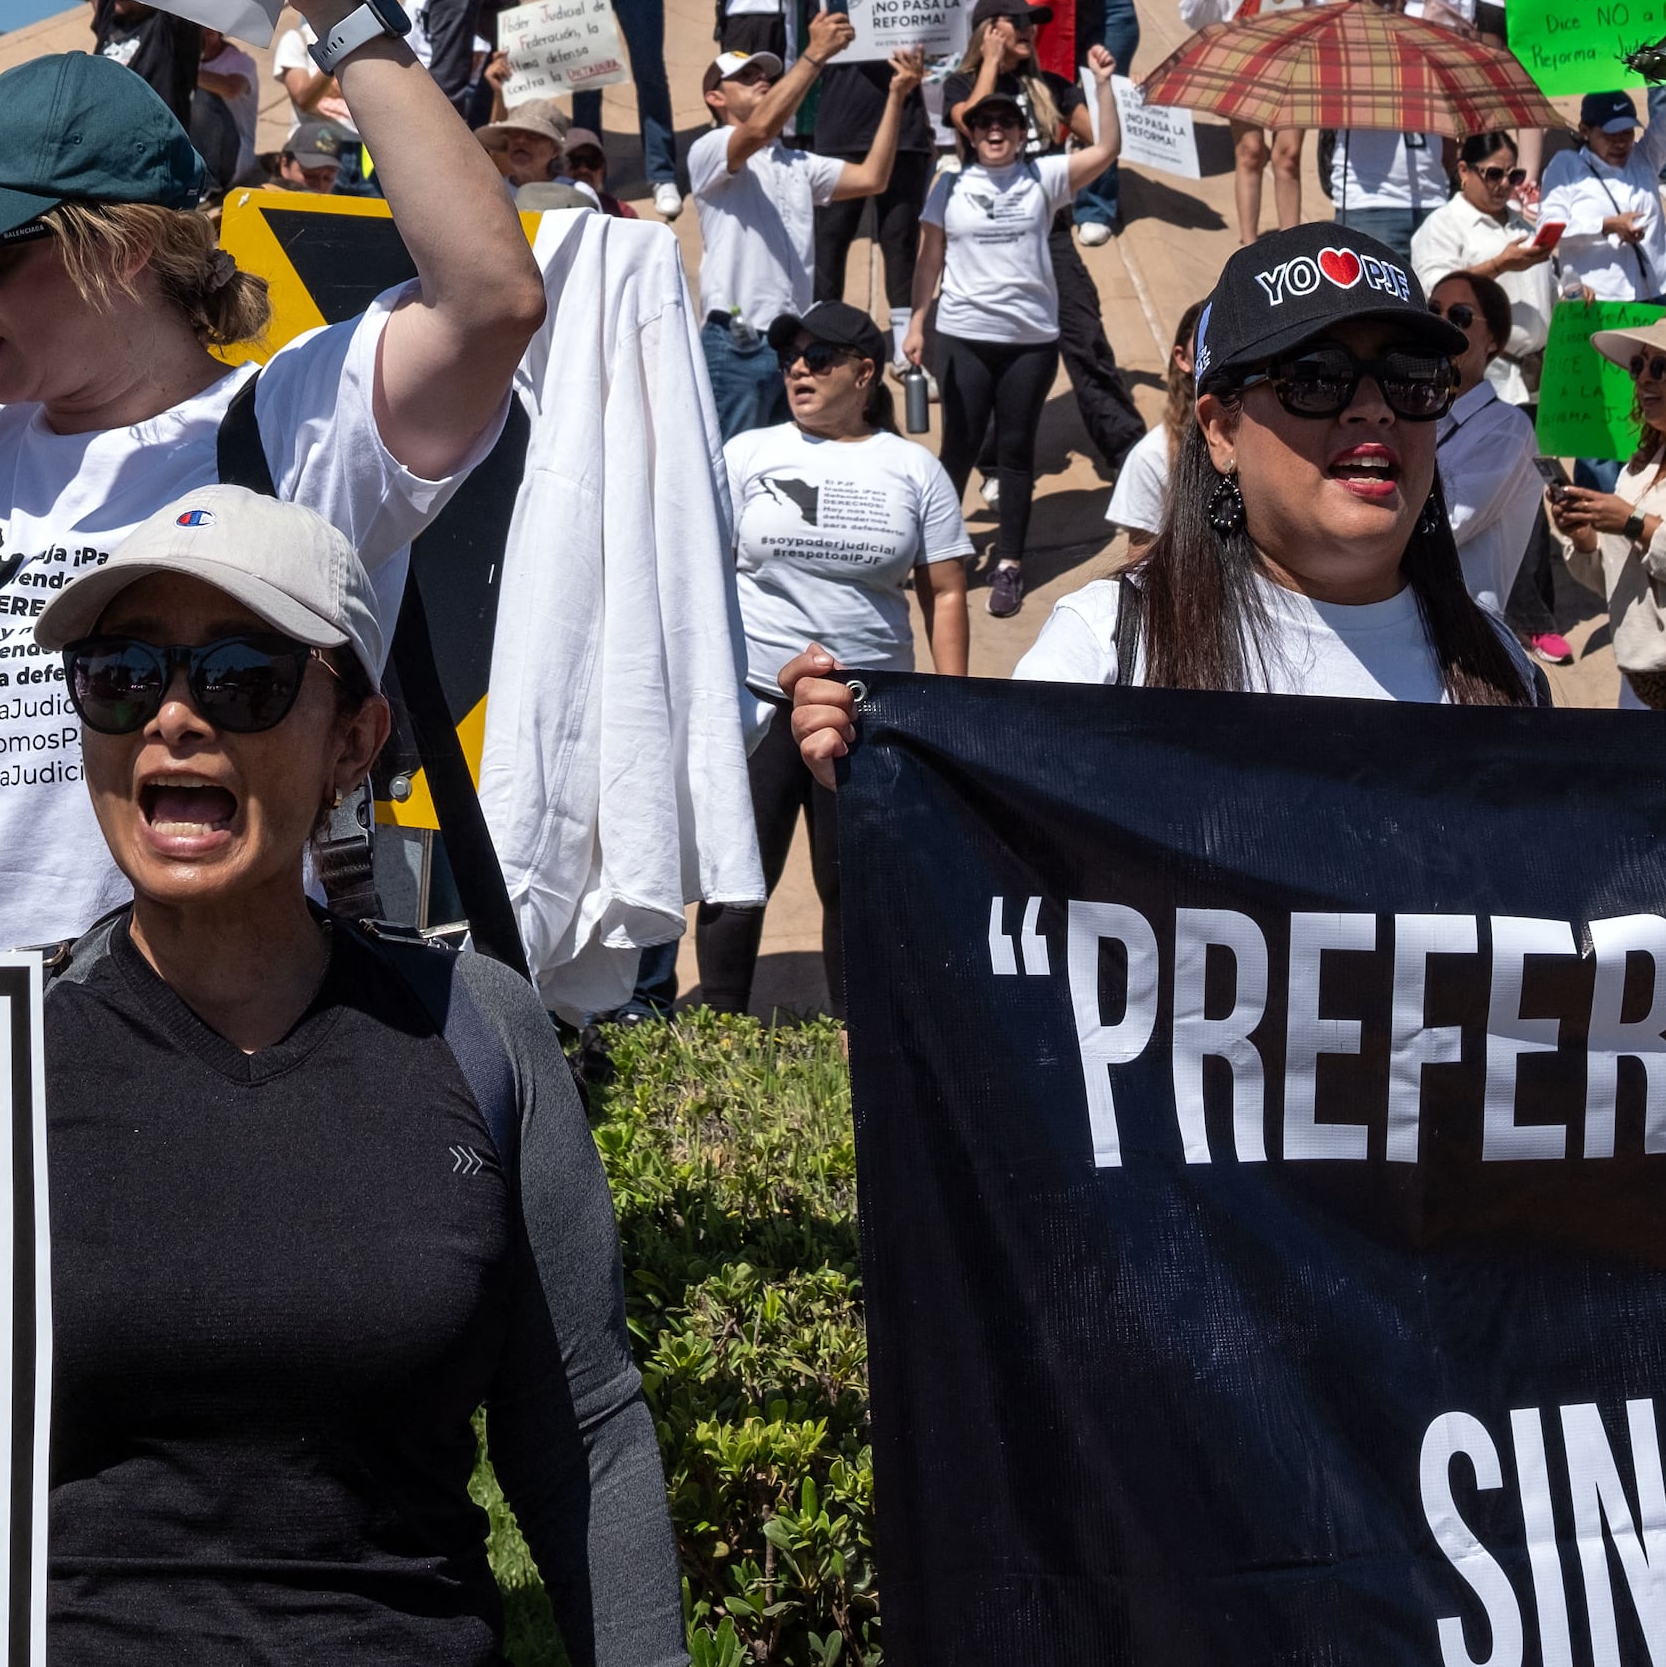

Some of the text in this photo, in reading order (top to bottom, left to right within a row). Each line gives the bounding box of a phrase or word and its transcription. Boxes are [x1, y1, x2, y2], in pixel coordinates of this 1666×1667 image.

[539, 1, 586, 24] Judicial
[871, 1, 898, 17] ¡NO
[903, 0, 941, 13] PASA
[872, 14, 946, 30] REFORMA!
[1546, 13, 1581, 35] Dice
[1597, 2, 1630, 27] NO
[1643, 9, 1654, 23] a
[587, 21, 599, 36] la
[1531, 44, 1597, 71] Reforma
[550, 70, 562, 83] la
[1255, 254, 1409, 307] YO PJF
[823, 506, 843, 515] Hoy
[823, 513, 889, 525] defendernos
[761, 535, 897, 557] #soypoderjudicial
